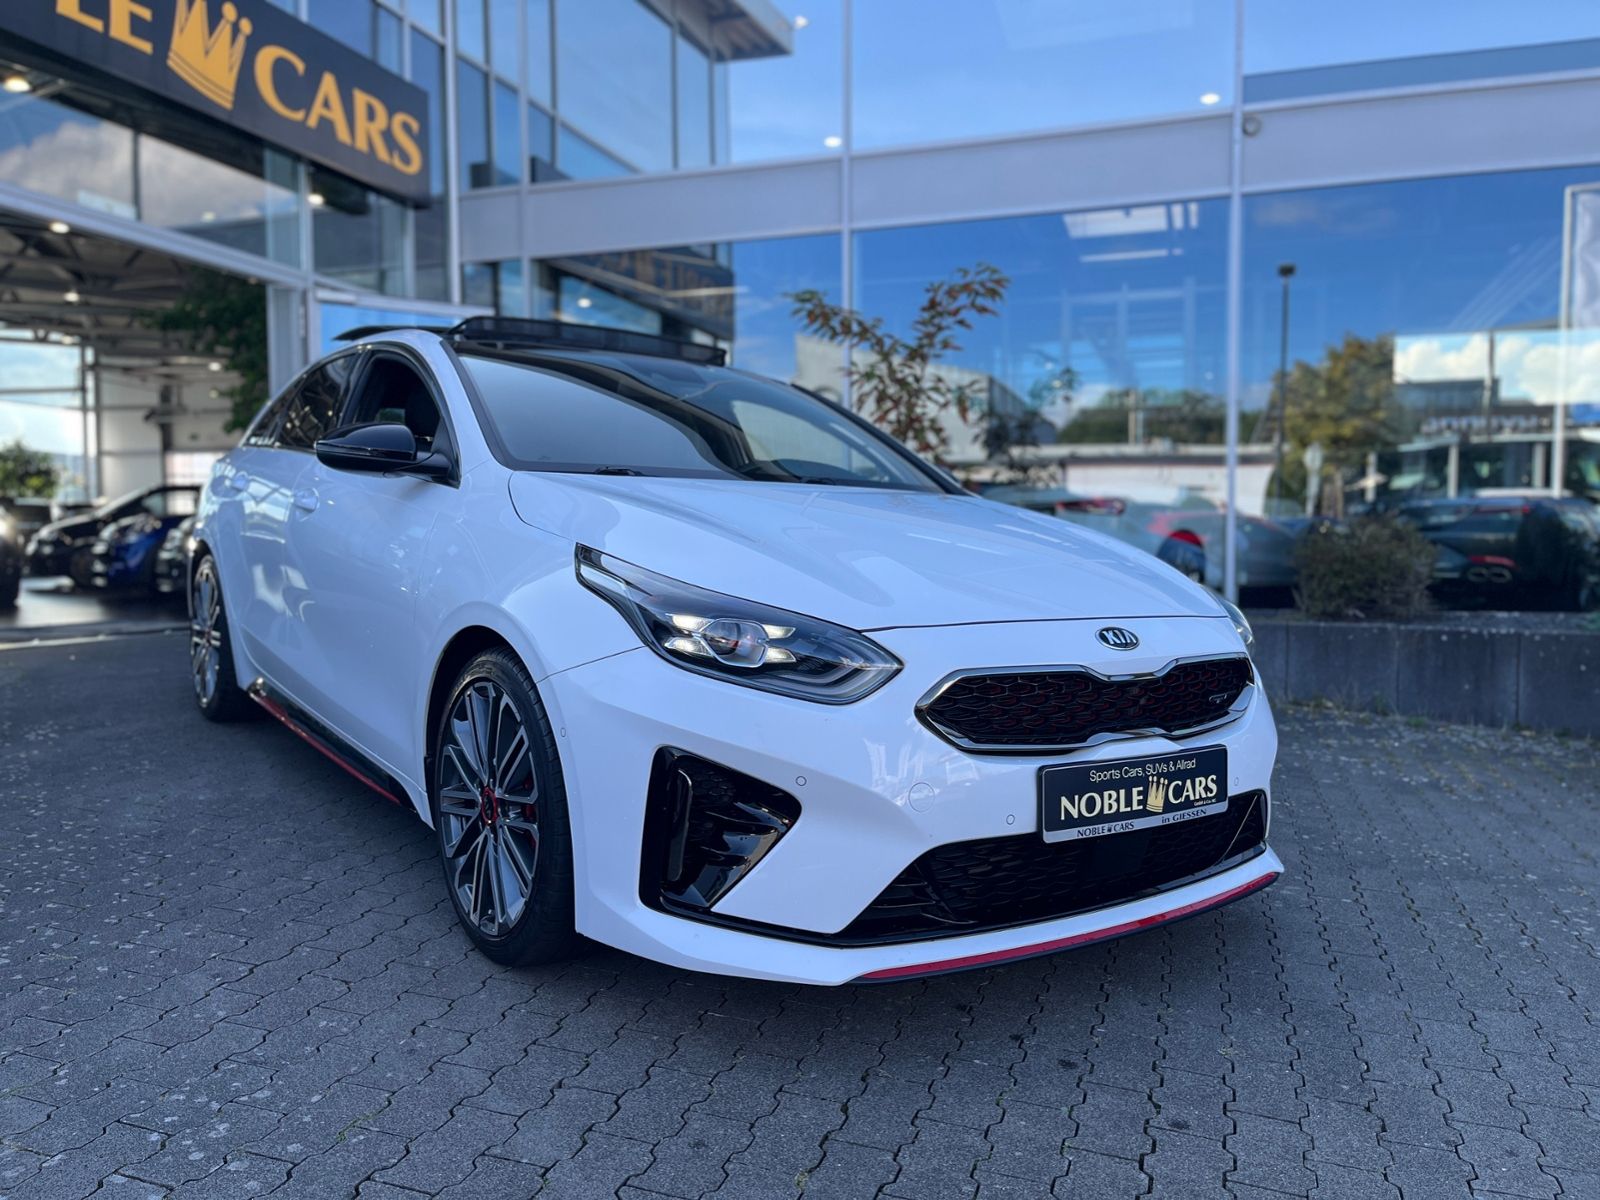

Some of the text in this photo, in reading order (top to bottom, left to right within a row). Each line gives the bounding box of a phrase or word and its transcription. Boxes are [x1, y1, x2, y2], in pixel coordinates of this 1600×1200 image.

[56, 0, 422, 175] E CARS
[1102, 629, 1138, 645] KIA
[1089, 758, 1196, 783] Sports Cars, SUVs & Allrad
[1060, 774, 1218, 820] NOBLE CARS
[1161, 808, 1207, 824] in GIESSEN
[1076, 821, 1135, 838] NOBLE CARS
